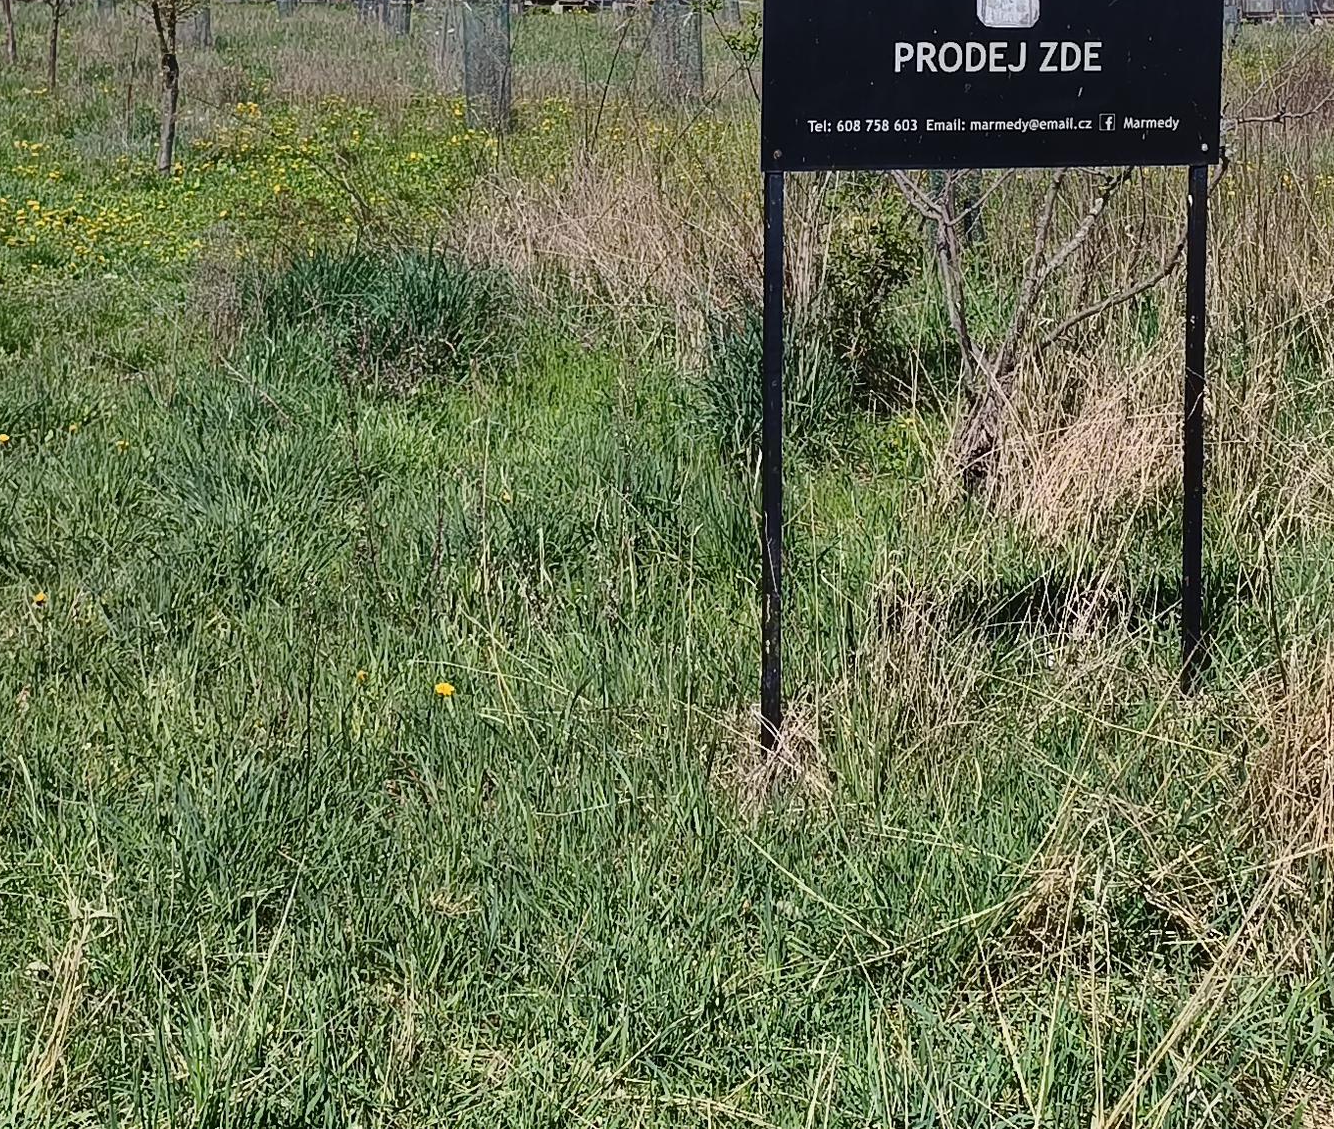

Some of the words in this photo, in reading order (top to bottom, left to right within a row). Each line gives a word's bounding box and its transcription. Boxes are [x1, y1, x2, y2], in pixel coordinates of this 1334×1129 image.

[894, 41, 1027, 73] PRODEJ
[1039, 41, 1102, 72] ZDE
[807, 119, 832, 133] Tel:
[836, 119, 861, 132] 608
[865, 119, 890, 132] 758
[893, 119, 918, 132] 603
[926, 118, 966, 132] Email:
[969, 117, 1093, 133] marmedy@email.cz
[1123, 115, 1180, 132] Marmedy
